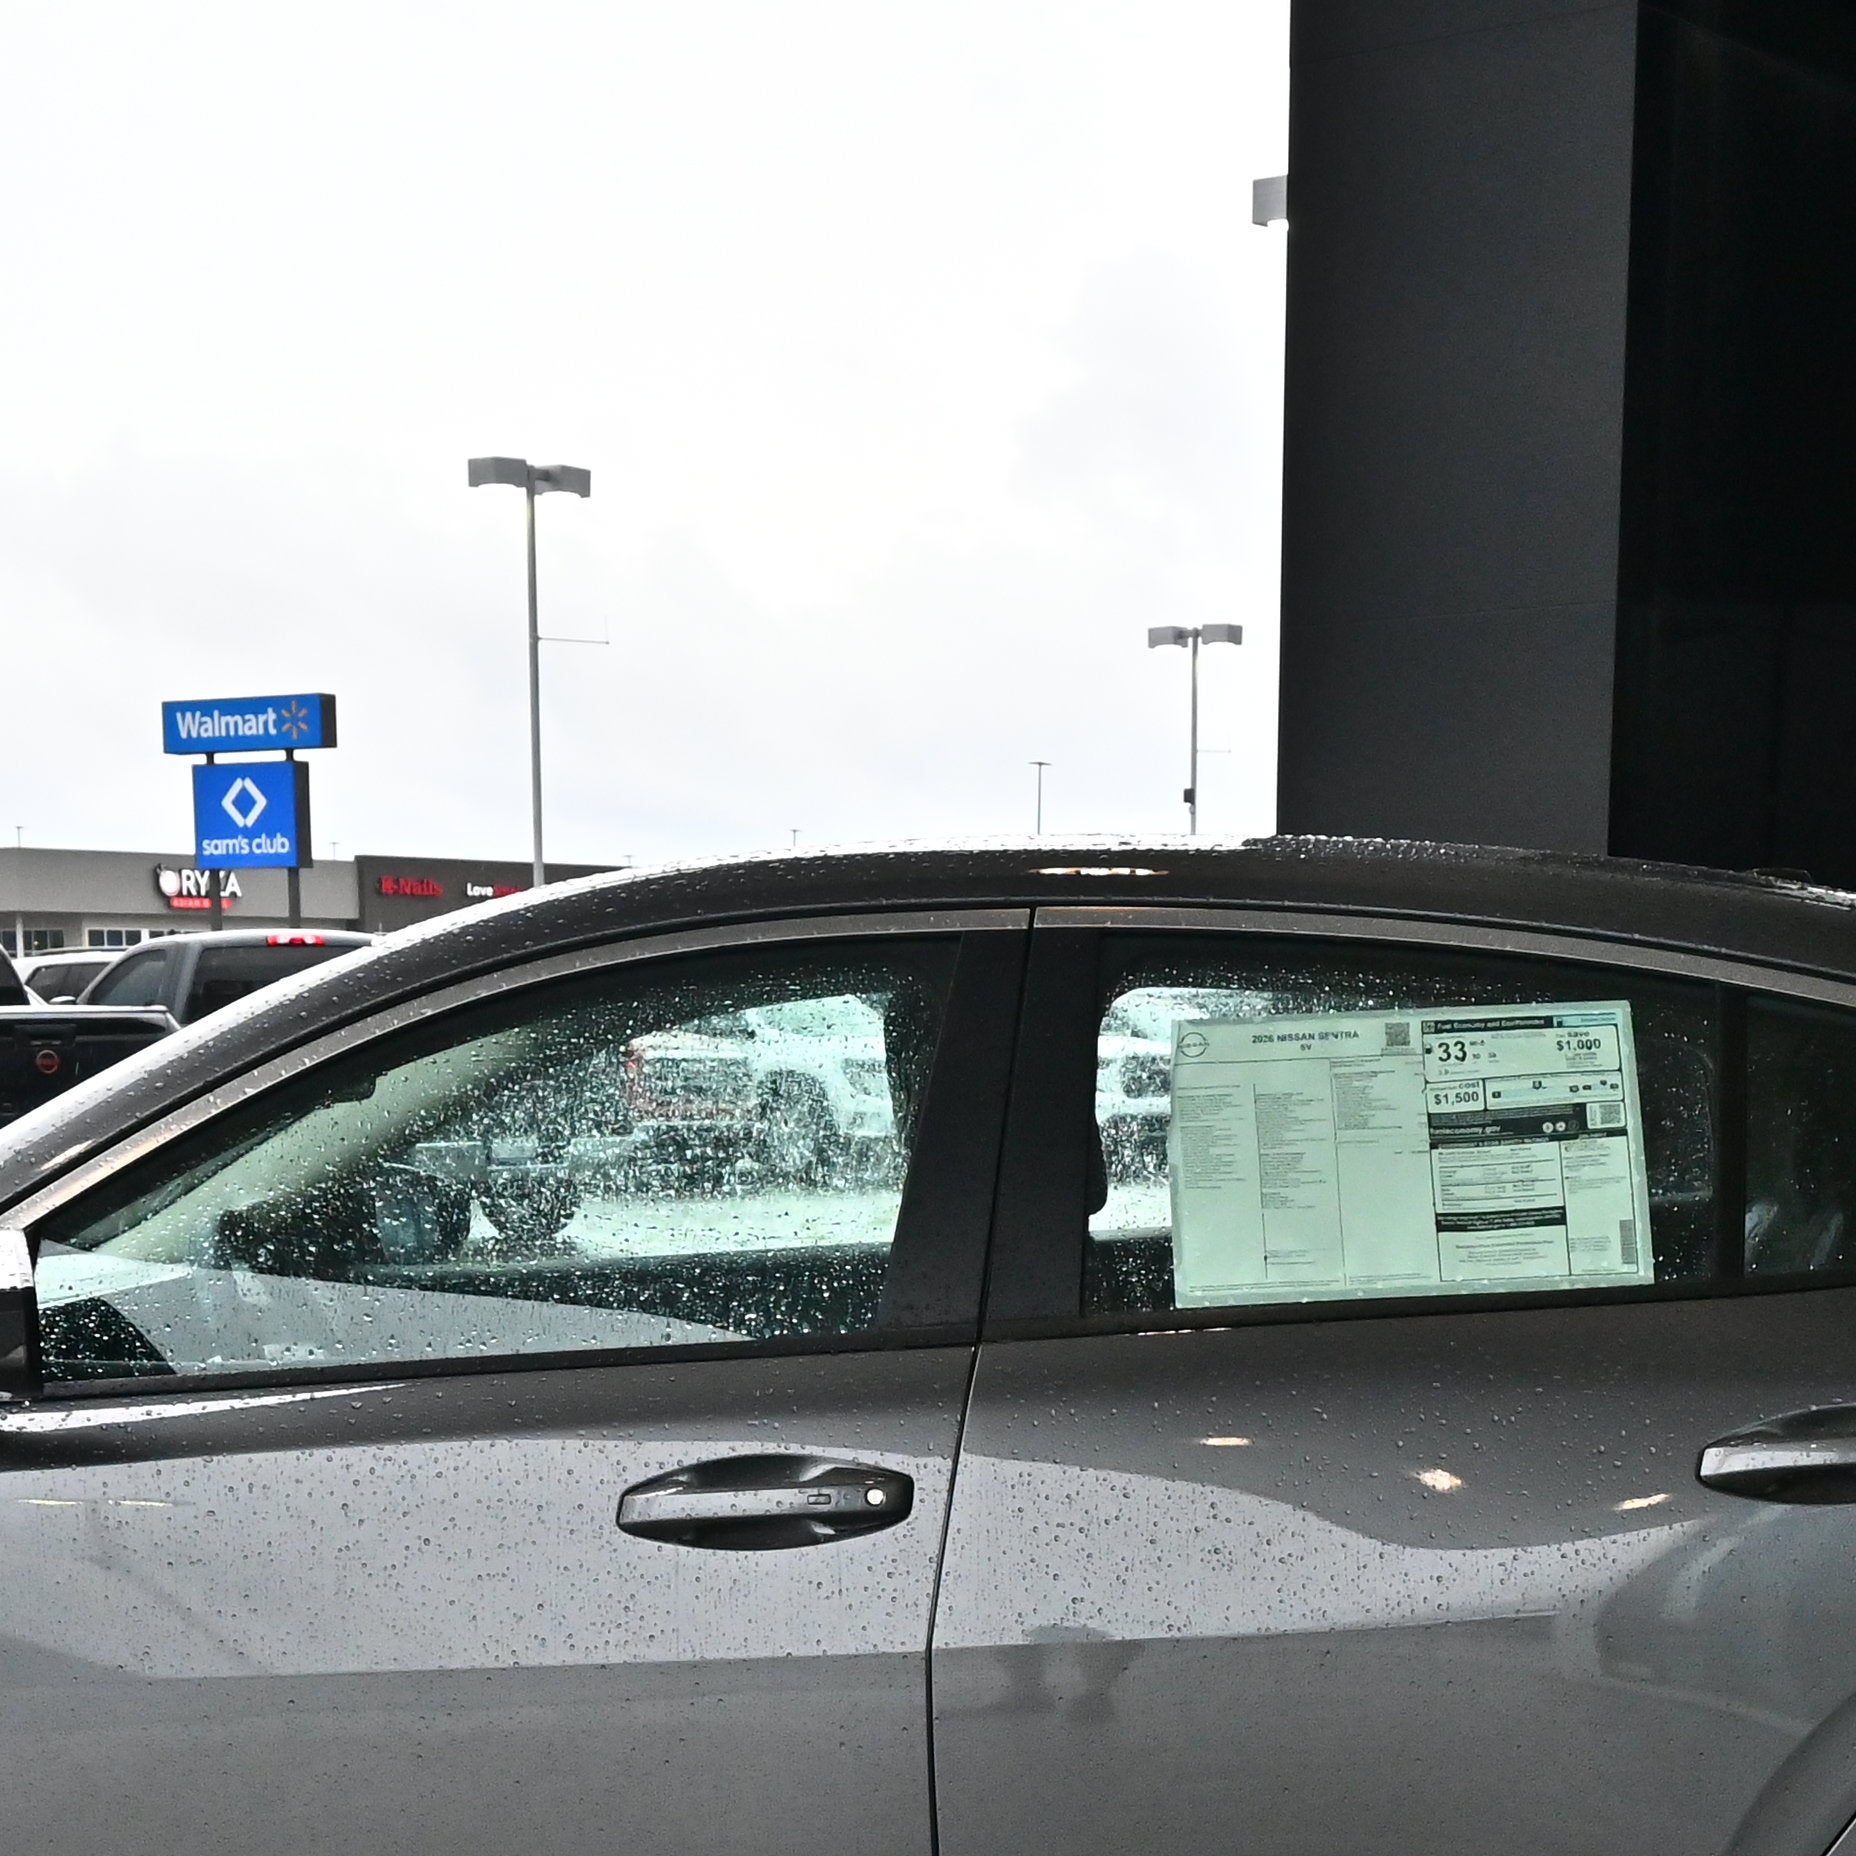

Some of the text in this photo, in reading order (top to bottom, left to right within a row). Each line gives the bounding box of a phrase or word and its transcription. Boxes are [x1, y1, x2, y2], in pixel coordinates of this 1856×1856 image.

[175, 707, 277, 739] Walmart
[201, 832, 290, 855] sam's club
[1277, 1031, 1315, 1042] NISSAN
[1556, 1038, 1602, 1051] $1,000
[1437, 1040, 1468, 1063] 33
[1433, 1091, 1480, 1106] $1,500
